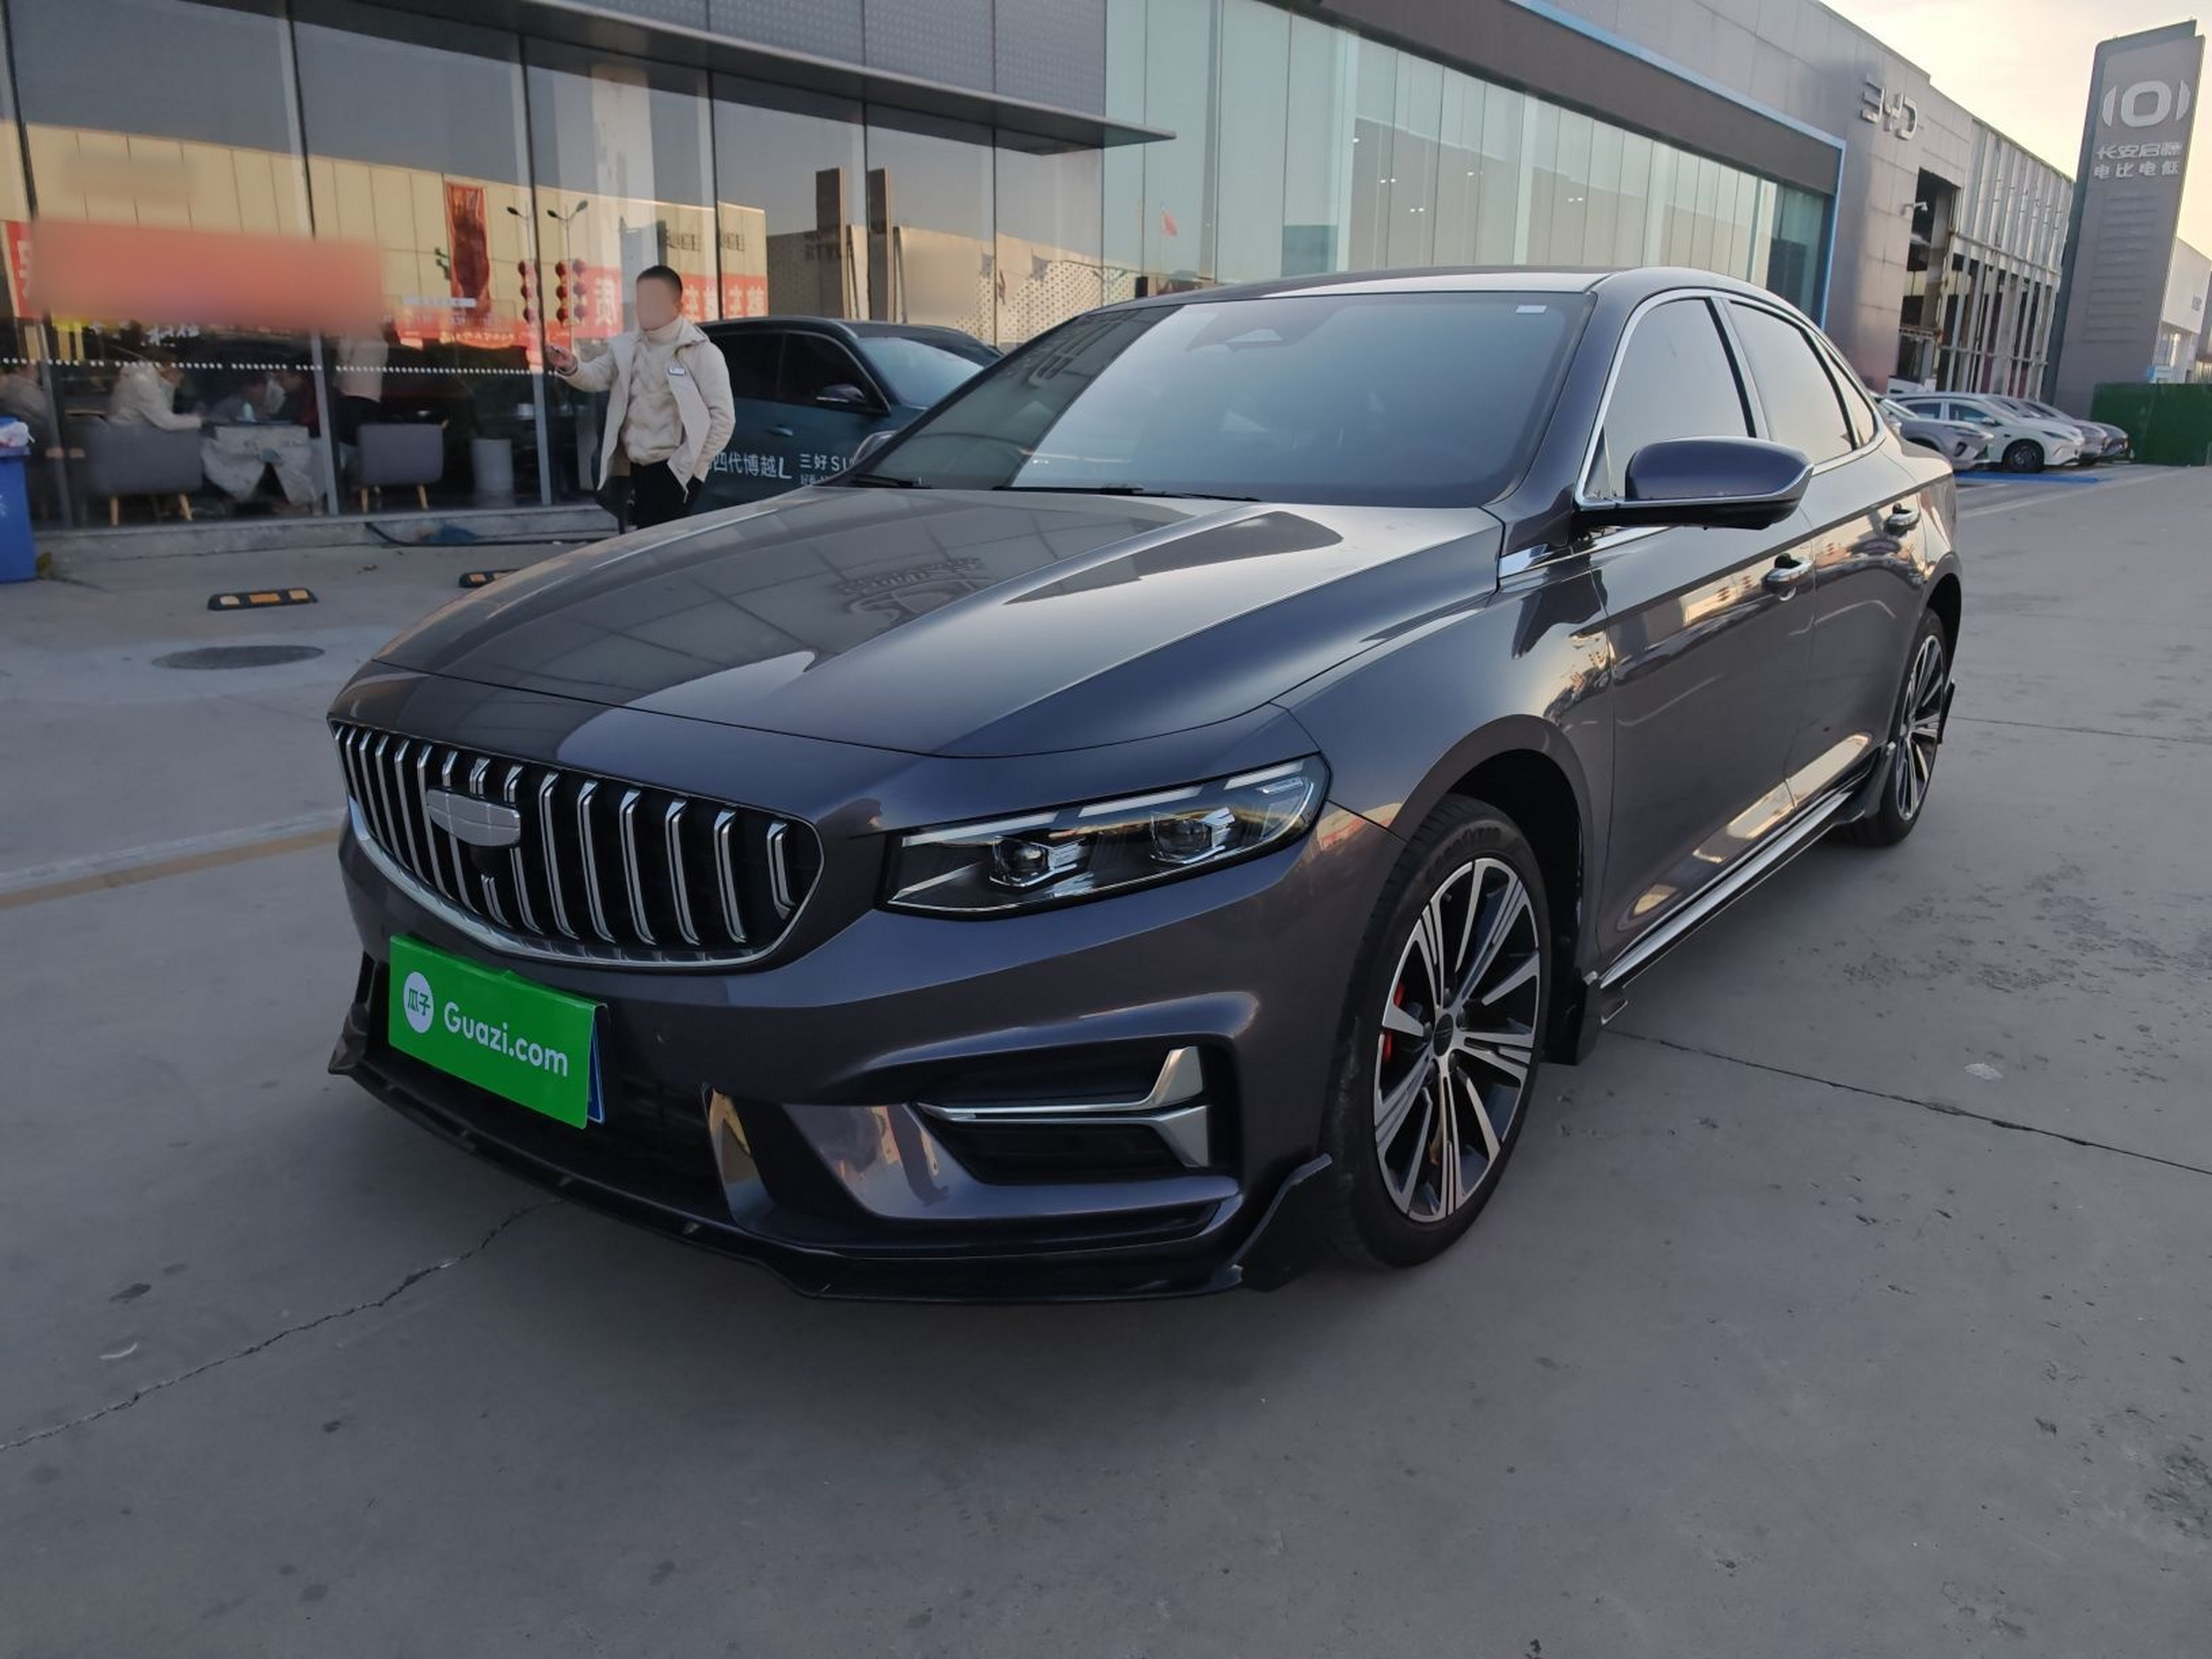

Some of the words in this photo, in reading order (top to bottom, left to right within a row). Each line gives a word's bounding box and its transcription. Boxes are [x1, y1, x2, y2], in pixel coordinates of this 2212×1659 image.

[708, 452, 792, 479] 四代博越L
[407, 988, 430, 1016] 瓜子
[444, 1001, 568, 1078] Guazi.com
